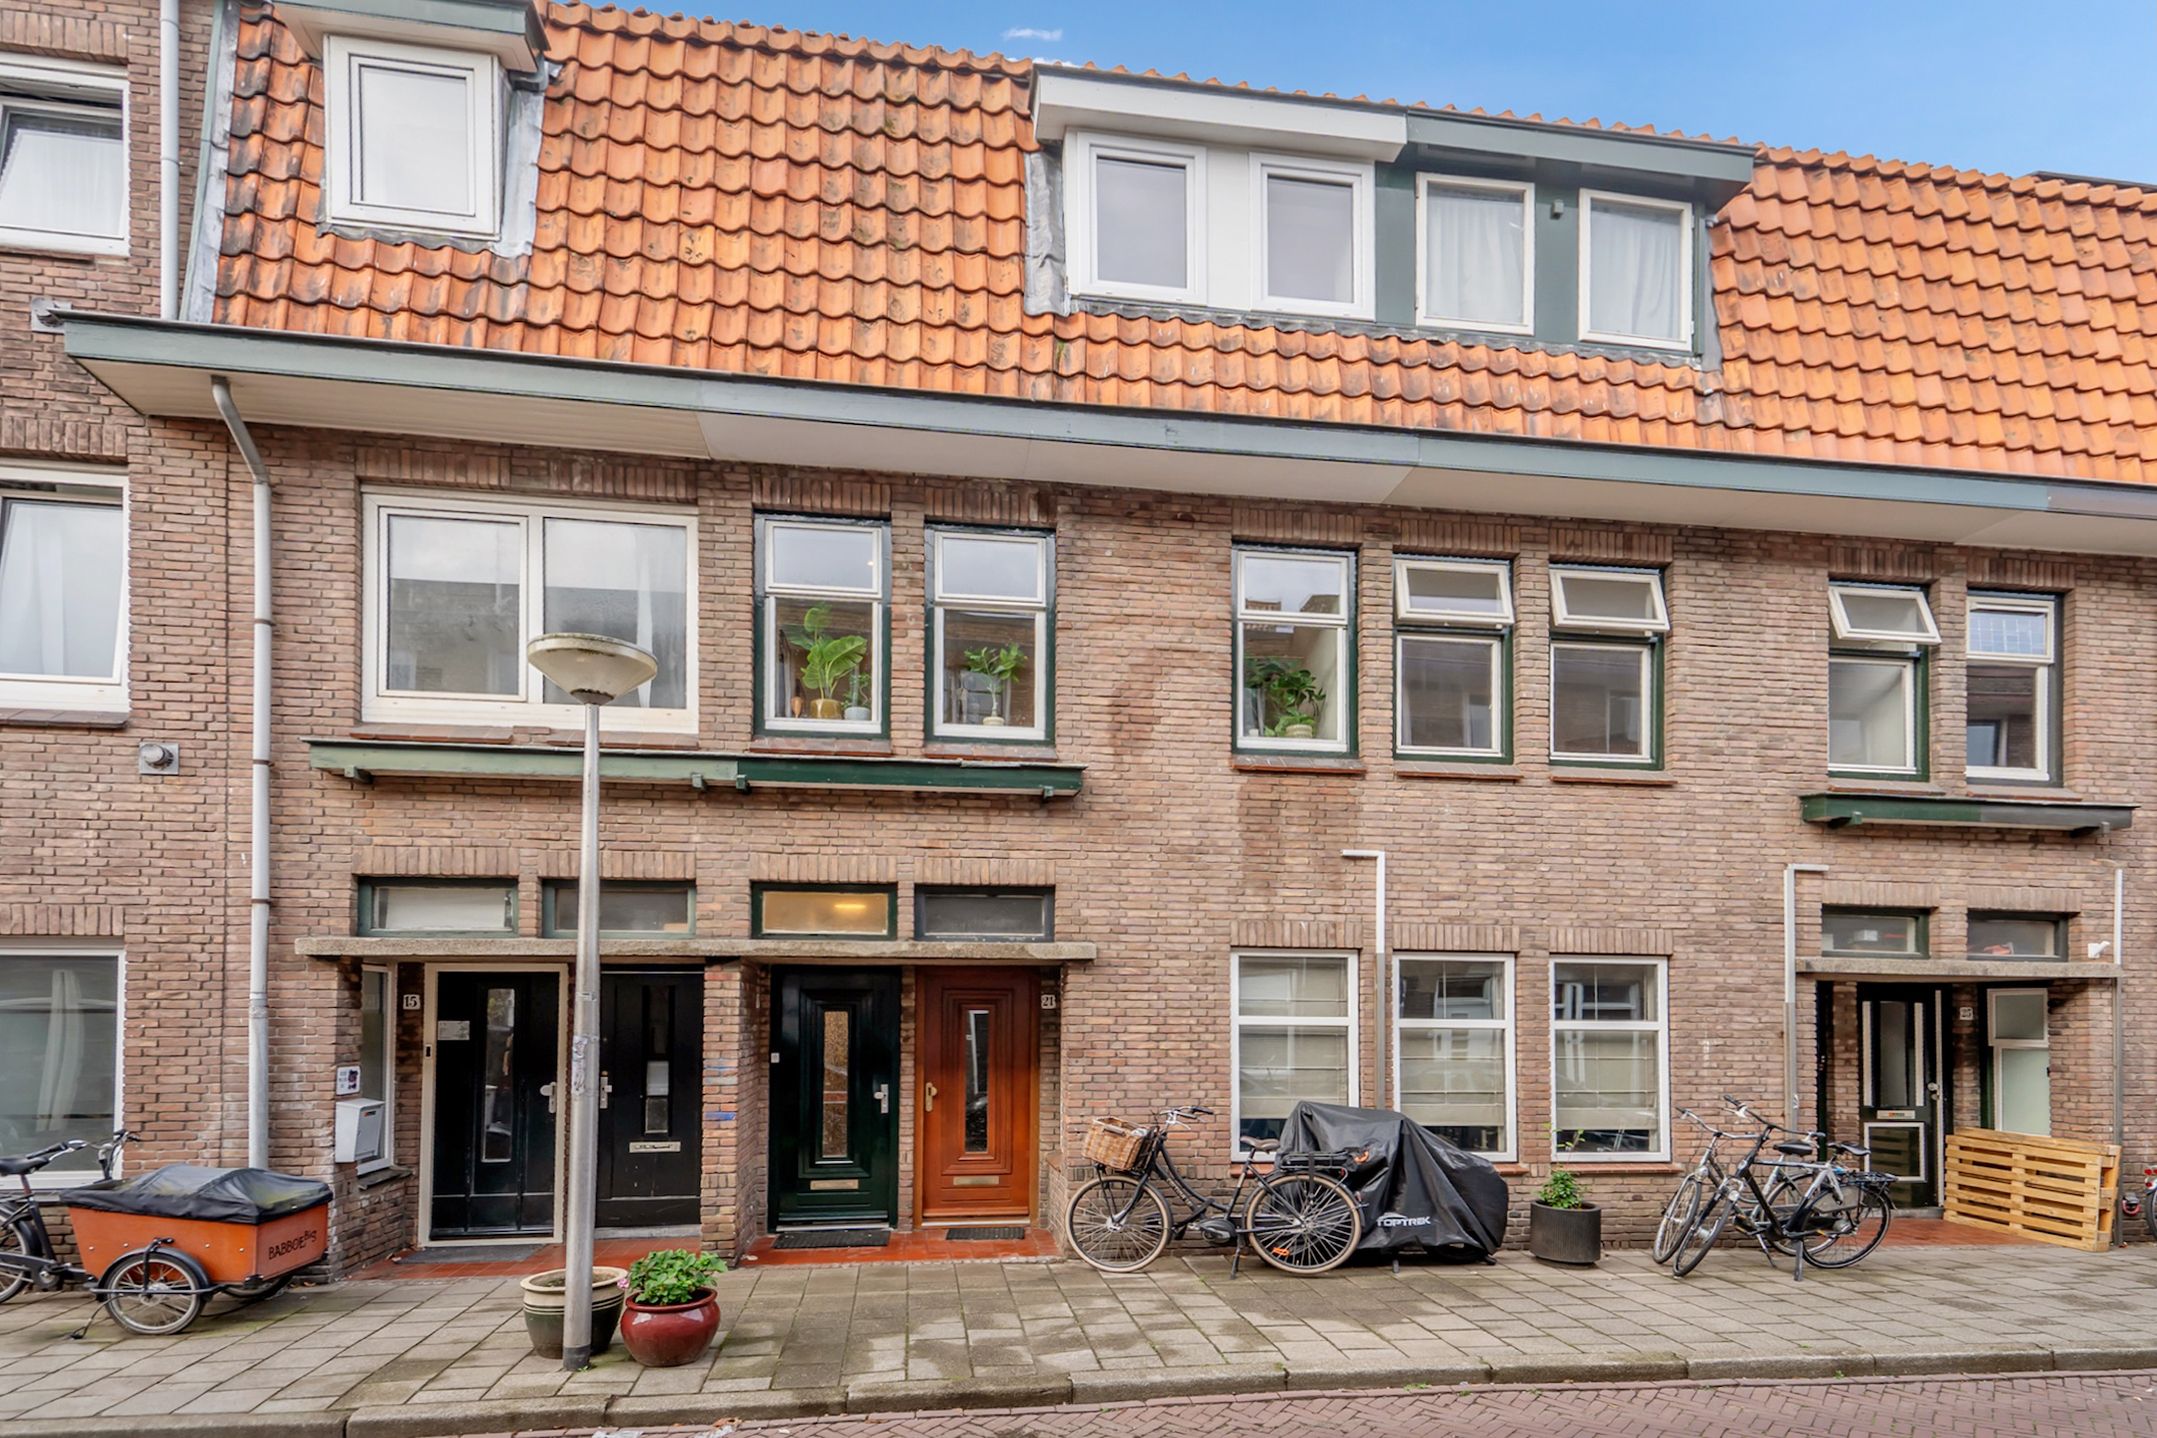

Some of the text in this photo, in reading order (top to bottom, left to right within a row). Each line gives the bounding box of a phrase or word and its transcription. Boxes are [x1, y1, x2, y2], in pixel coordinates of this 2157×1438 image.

[404, 995, 418, 1008] 15
[1042, 996, 1054, 1007] 21
[1376, 1215, 1432, 1227] TOPTREK
[268, 1236, 307, 1260] BABBOE
